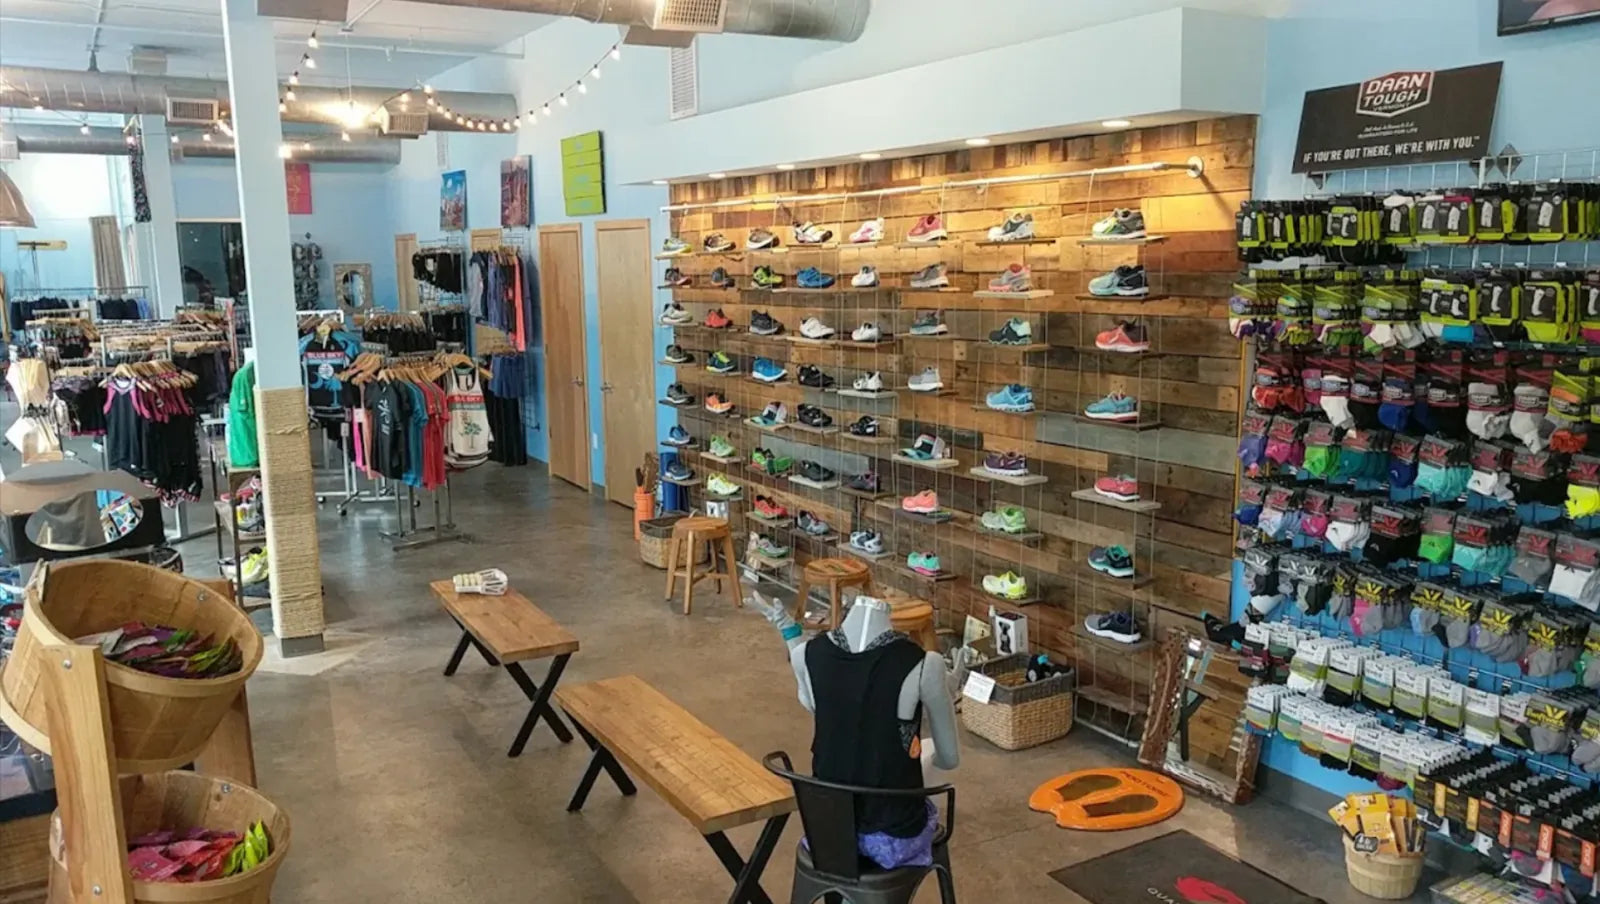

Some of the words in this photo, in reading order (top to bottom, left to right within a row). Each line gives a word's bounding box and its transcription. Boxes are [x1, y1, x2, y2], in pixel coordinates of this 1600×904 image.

[1366, 73, 1426, 94] DARN
[1364, 89, 1421, 108] TOUGH
[1373, 102, 1411, 112] VERMONT
[1303, 152, 1312, 164] IF
[1313, 149, 1342, 162] YOU'RE
[1344, 147, 1361, 160] OUT
[1362, 144, 1392, 158] THERE,
[1394, 141, 1424, 155] WE'RE
[1425, 138, 1451, 152] WITH
